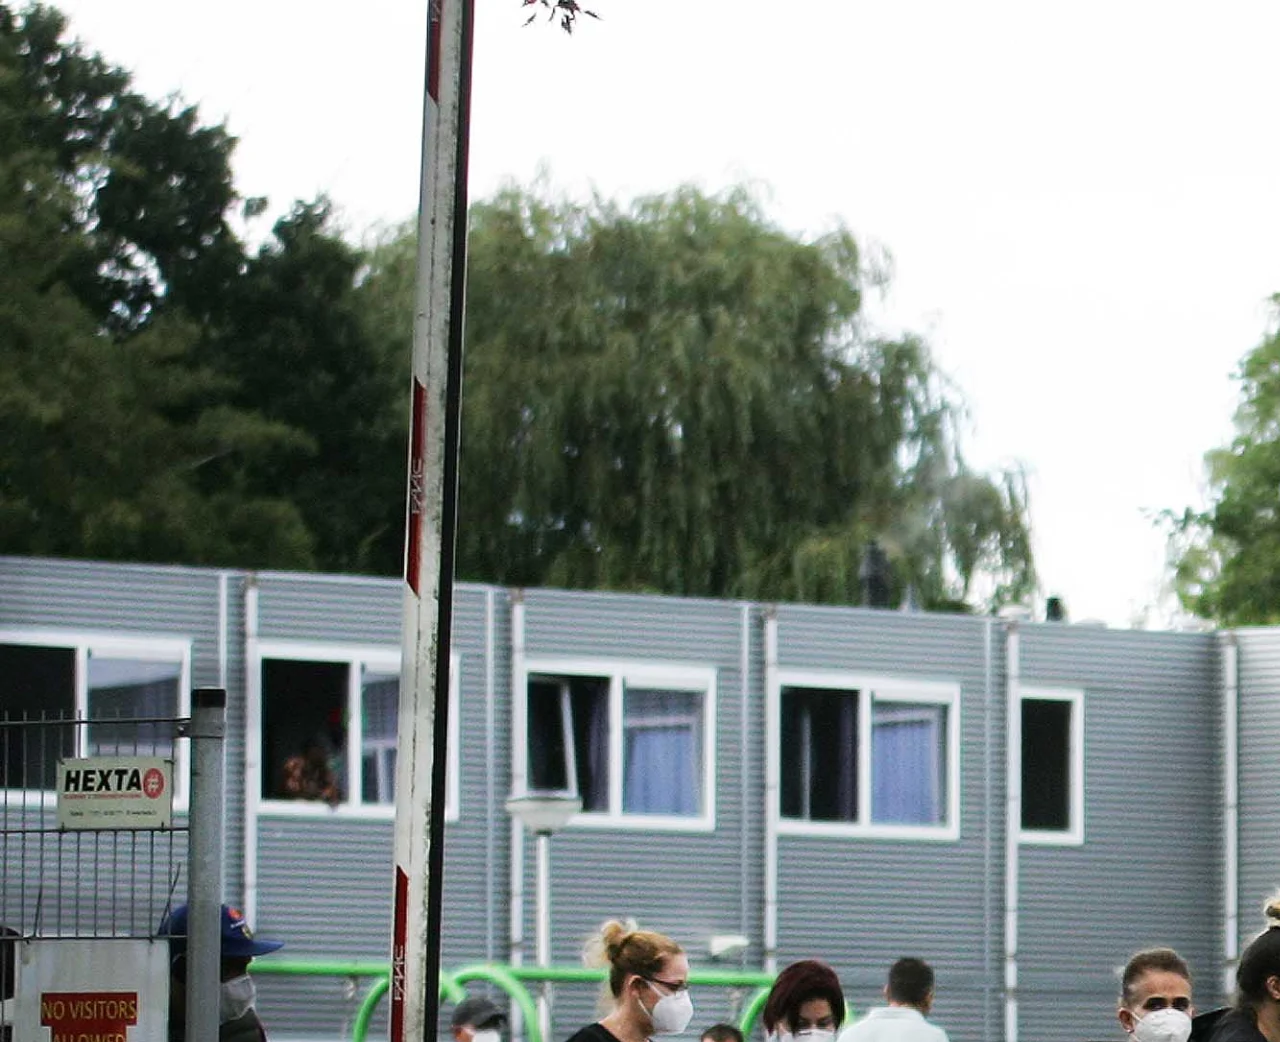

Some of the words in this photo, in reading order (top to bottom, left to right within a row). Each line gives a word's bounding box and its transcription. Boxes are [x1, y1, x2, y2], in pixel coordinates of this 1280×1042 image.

[64, 768, 142, 792] HEXTA
[394, 944, 406, 1000] FAAC
[42, 1001, 65, 1020] NO
[69, 1001, 137, 1020] VISITORS
